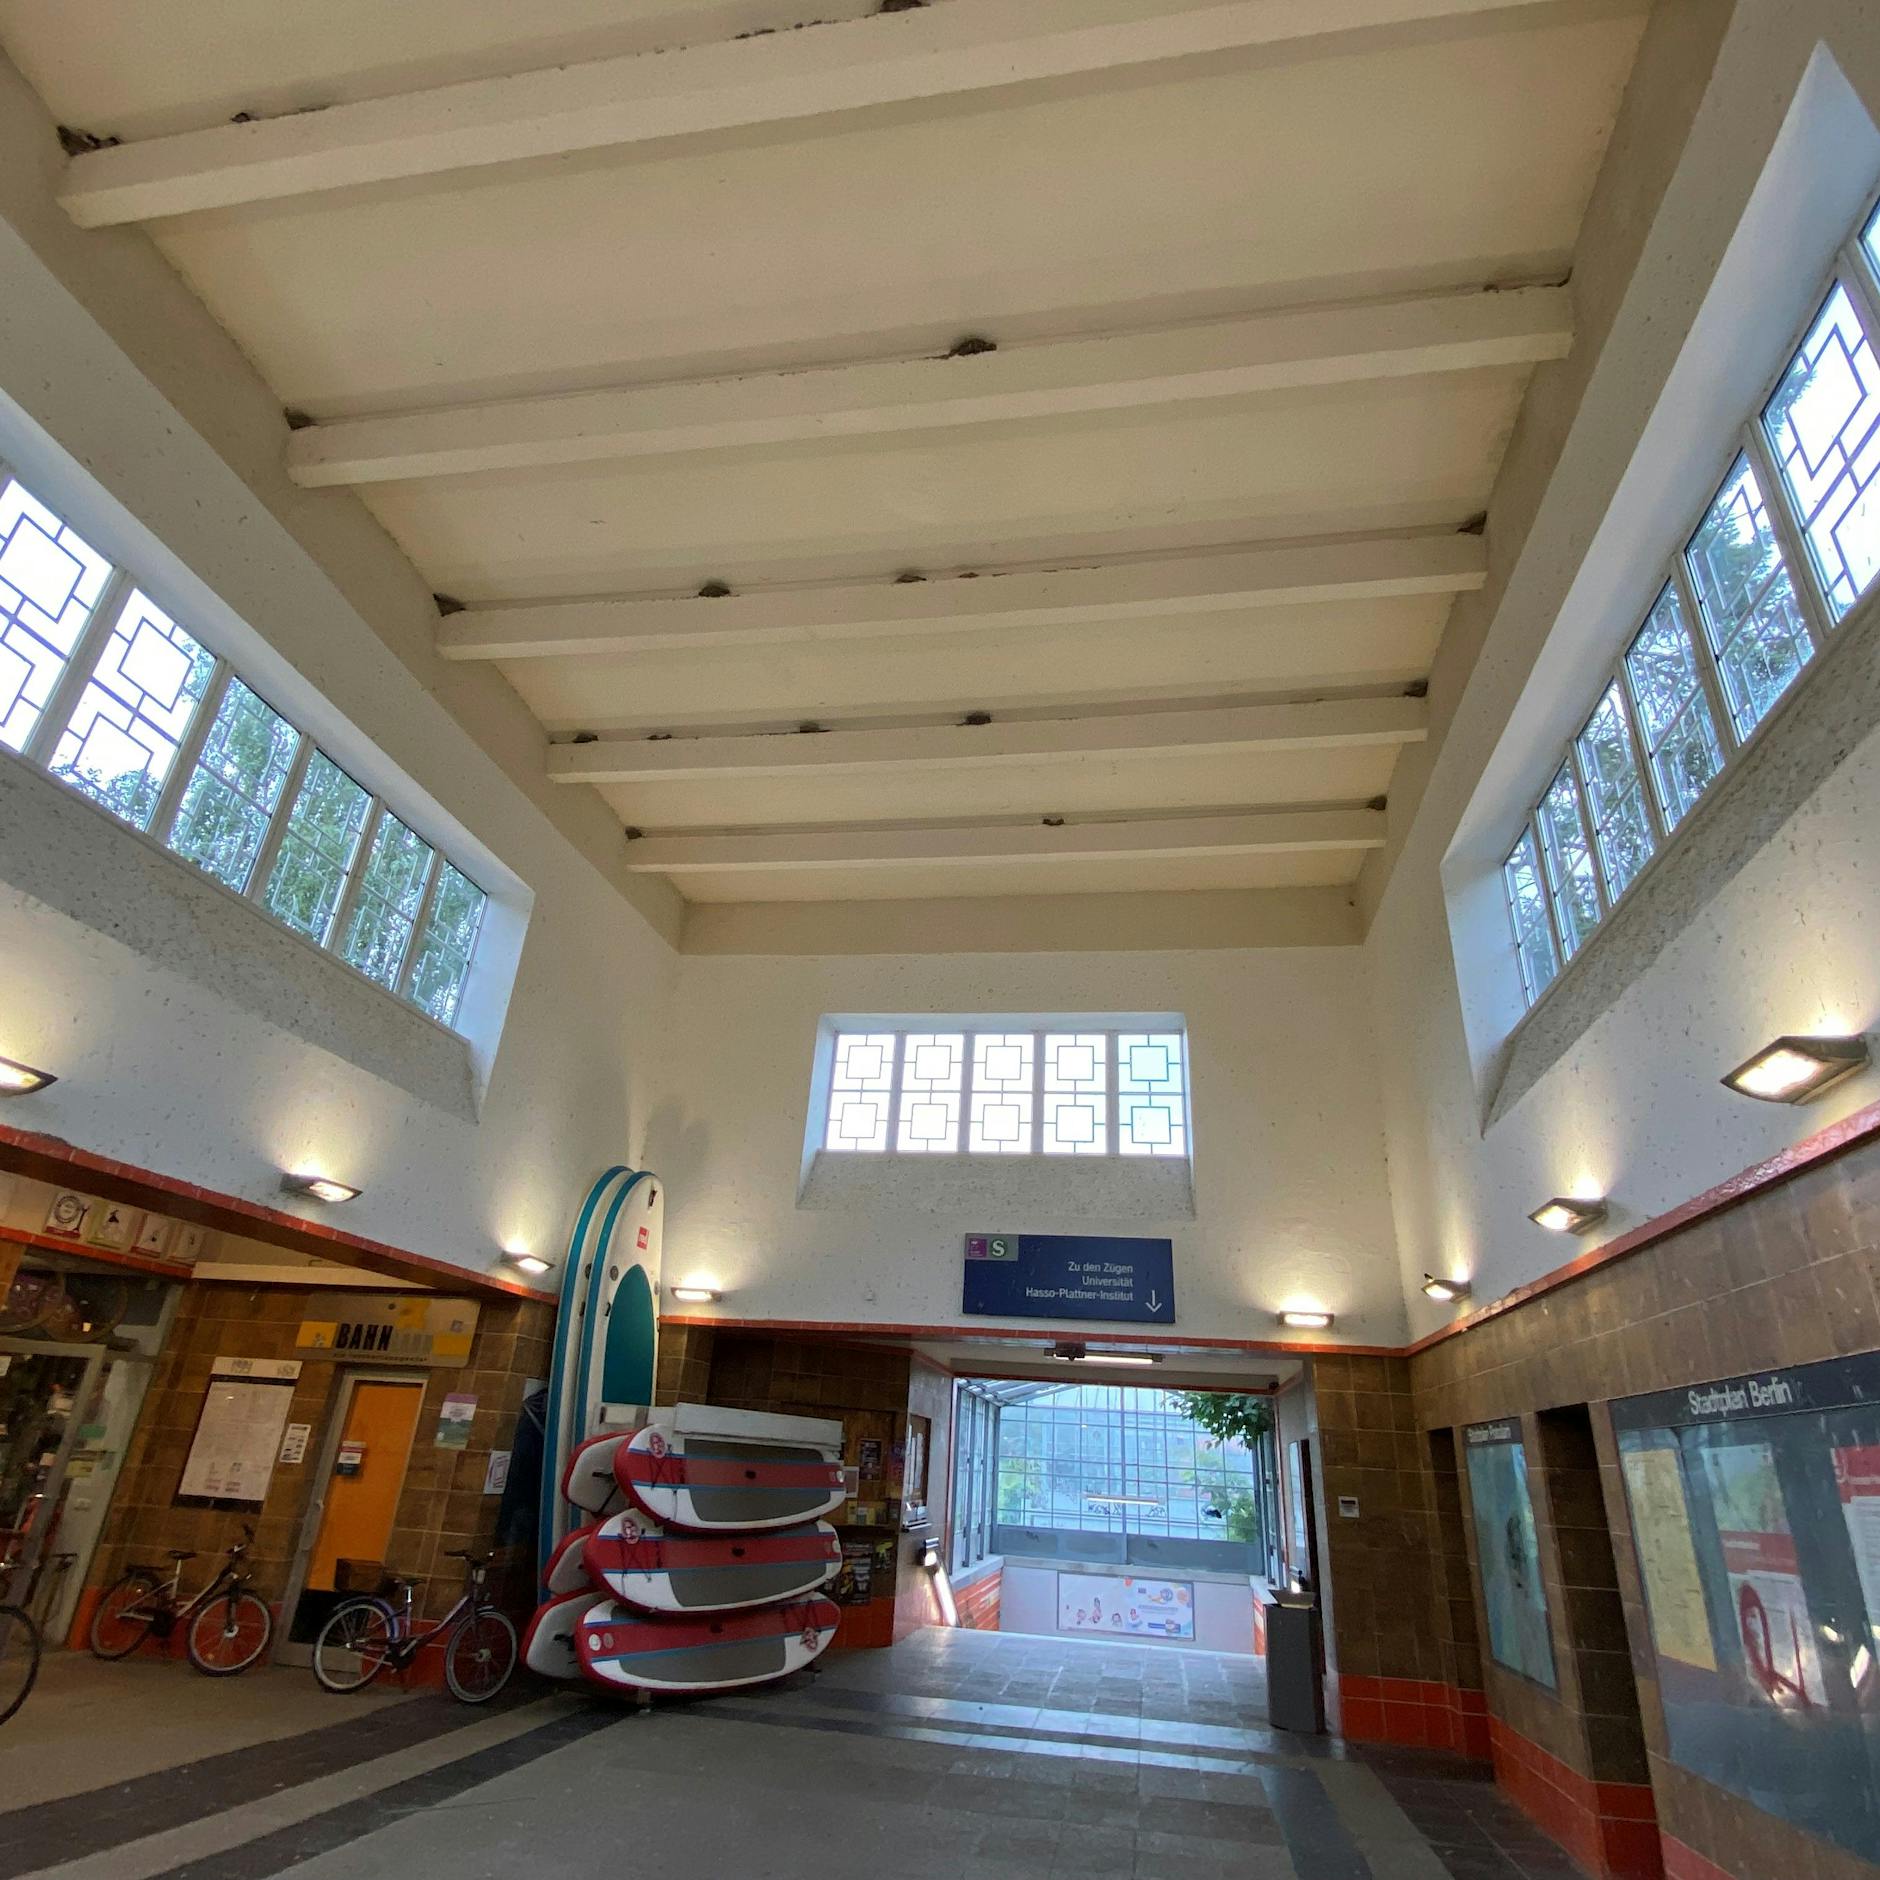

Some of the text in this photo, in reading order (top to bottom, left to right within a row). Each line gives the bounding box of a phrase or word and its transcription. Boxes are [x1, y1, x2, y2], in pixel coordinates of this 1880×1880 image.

[992, 1240, 1005, 1256] S
[1068, 1261, 1133, 1276] Zu den Zügen
[1082, 1275, 1133, 1288] Universität
[1026, 1287, 1133, 1301] Hasso-Plattner-Institut
[336, 1322, 393, 1351] BAHN
[1688, 1376, 1792, 1417] Stadtplan Berlin
